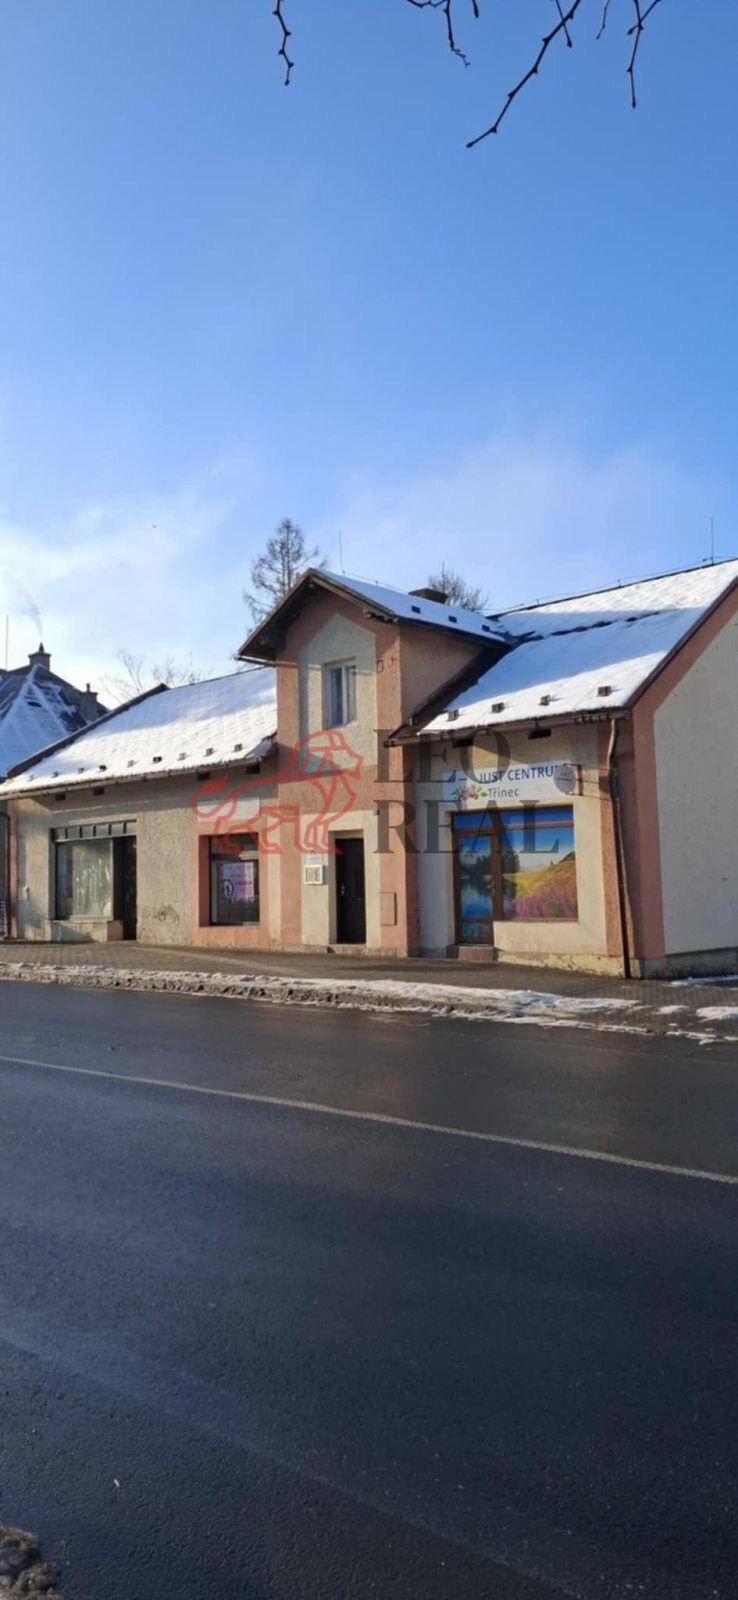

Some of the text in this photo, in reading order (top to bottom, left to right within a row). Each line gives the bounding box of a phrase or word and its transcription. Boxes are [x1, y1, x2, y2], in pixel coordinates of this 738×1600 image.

[479, 769, 504, 784] JUST
[507, 764, 564, 781] CENTRU
[488, 785, 520, 799] Třinec
